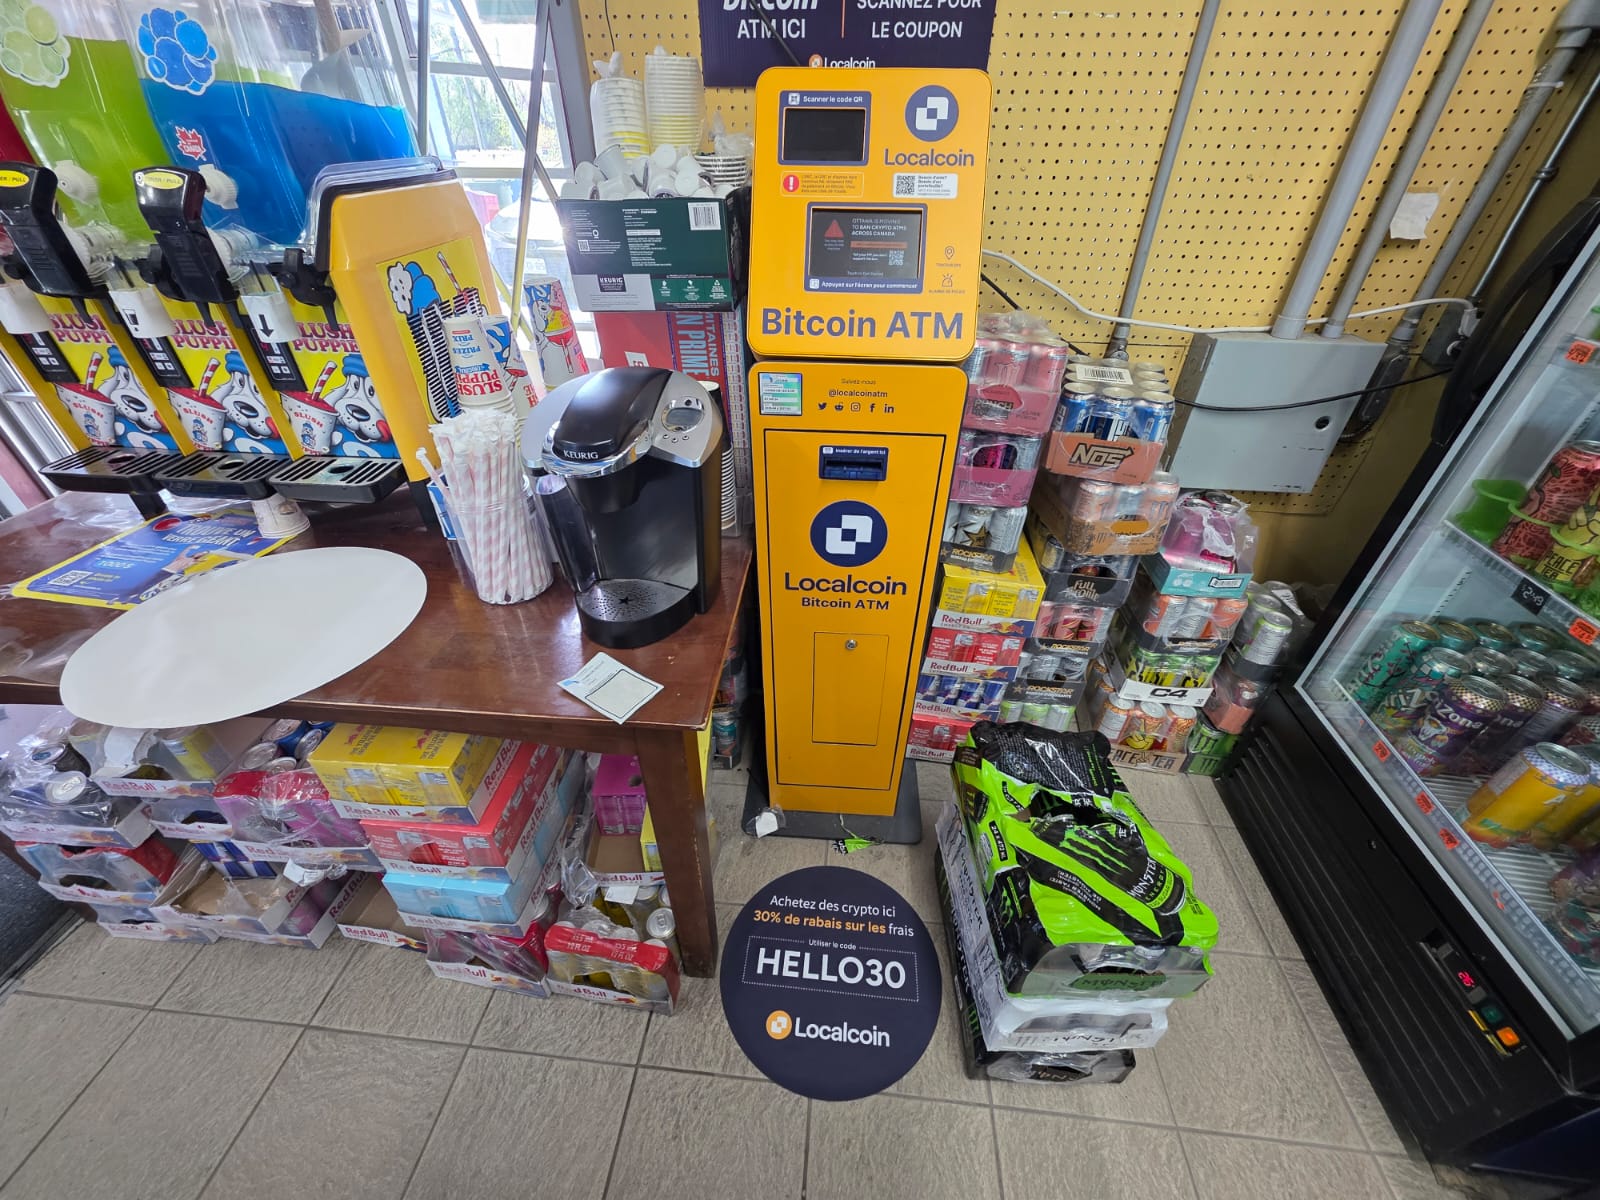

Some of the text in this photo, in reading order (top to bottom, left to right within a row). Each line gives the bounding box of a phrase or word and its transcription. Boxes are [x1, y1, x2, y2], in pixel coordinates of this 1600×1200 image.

[722, 0, 818, 11] Bicoin
[857, 0, 982, 9] SCANNEZ POUR
[737, 18, 806, 39] ATM ICI
[871, 21, 963, 39] LE COUPON
[824, 56, 876, 69] Localcoin
[802, 95, 829, 104] Scanner
[829, 95, 836, 103] le
[836, 95, 852, 104] code
[883, 147, 976, 167] Localcoin
[48, 313, 107, 331] SLUS
[299, 322, 355, 340] LUSH
[761, 307, 964, 340] Bitcoin ATM
[54, 330, 117, 344] PUPPI
[677, 330, 711, 377] PRIME
[828, 388, 889, 399] @localcoinatm
[563, 450, 599, 460] KEURIG
[1069, 442, 1134, 469] NOS
[784, 572, 907, 595] Localcoin
[801, 597, 889, 610] Bitcoin ATM
[1026, 684, 1075, 695] ROCKSTAR
[1150, 687, 1189, 699] C4
[1152, 754, 1176, 770] TEA
[769, 895, 896, 918] Achetez des crypto ici
[753, 910, 915, 937] 30% de rabais sur les frais
[808, 939, 857, 950] Utiliser le code
[756, 948, 906, 989] HELLO30
[794, 1016, 891, 1048] Localcoin
